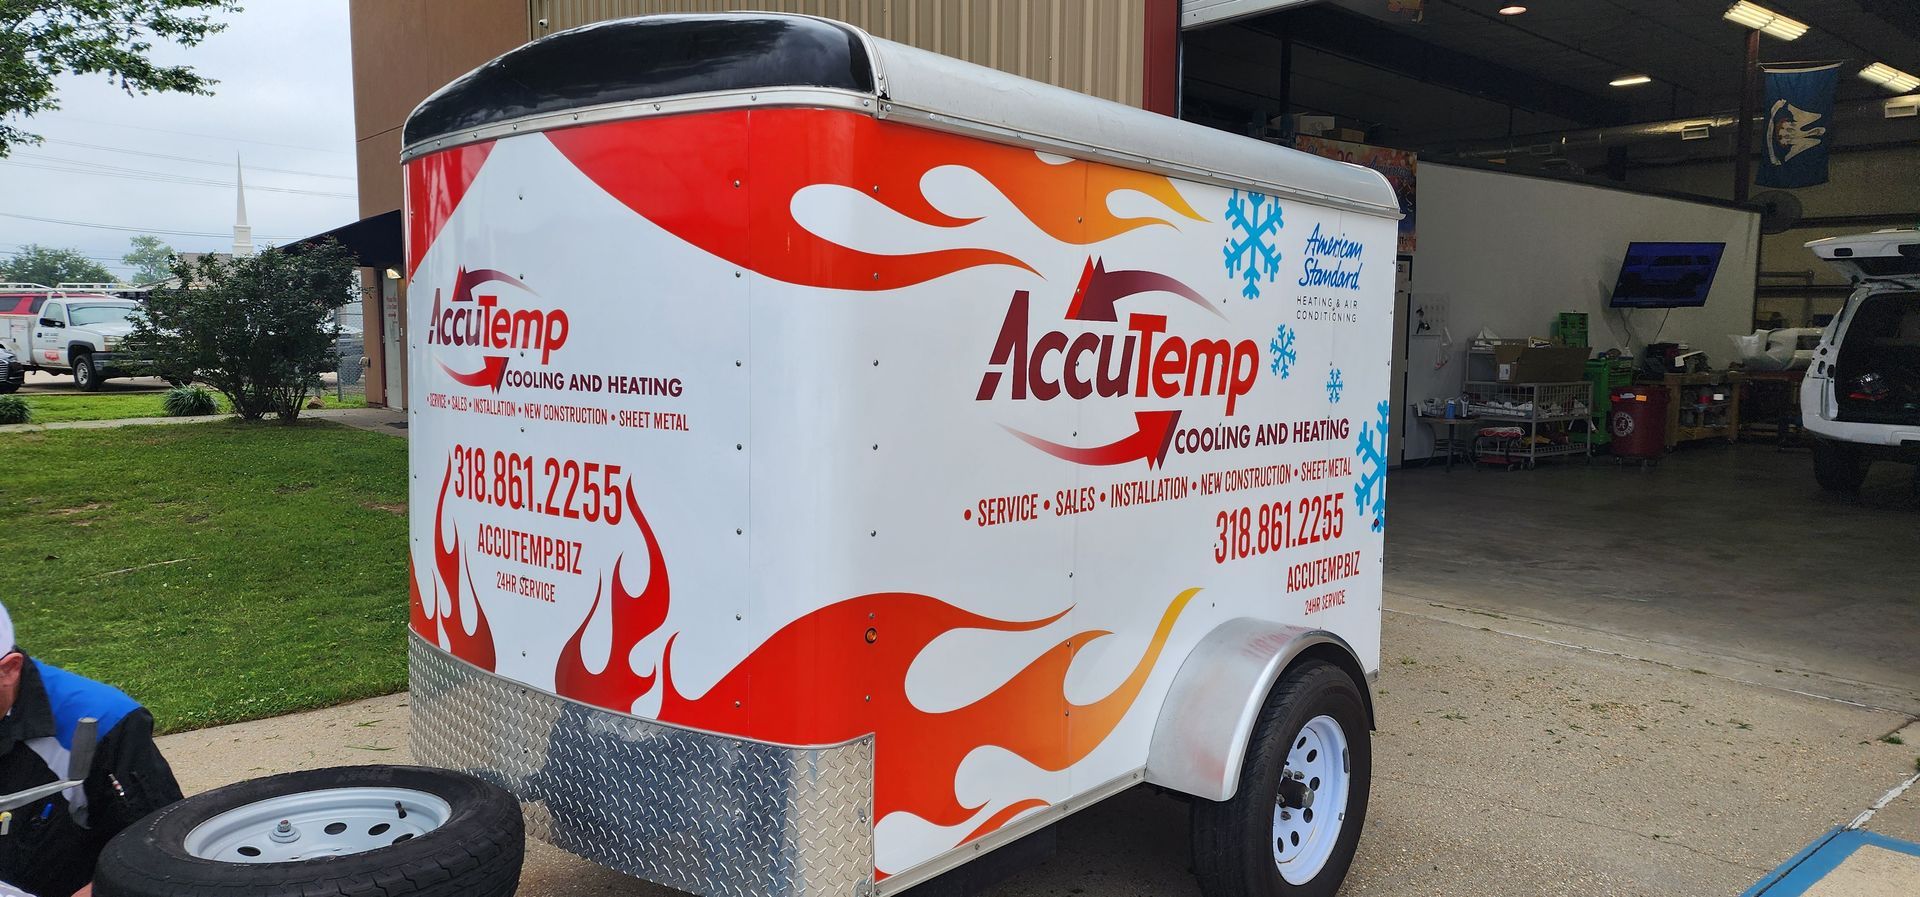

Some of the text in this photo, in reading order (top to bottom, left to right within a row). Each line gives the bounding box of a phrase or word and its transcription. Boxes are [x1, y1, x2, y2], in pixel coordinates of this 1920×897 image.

[1304, 222, 1363, 260] American
[1296, 296, 1358, 309] HEATING & AIR
[1296, 310, 1357, 323] CONDITIONING
[428, 288, 569, 365] AccuTemp
[975, 289, 1260, 416] AccuTemp
[505, 369, 683, 397] COOLING AND HEATING
[429, 392, 690, 431] SERVICE SALES INSTALLATION NEW CONSTRUCTION SHEET METAL
[1174, 418, 1350, 455] COOLING AND HEATING
[454, 443, 623, 526] 318.861.2255
[978, 493, 1039, 527] SERVICE
[1055, 486, 1096, 517] SALES
[1110, 476, 1189, 508] INSTALLATION
[1200, 472, 1223, 496] NEW
[1225, 464, 1292, 492] CONSTRUCTION
[1214, 492, 1345, 564] 318.861.2255
[477, 523, 583, 575] ACCUTEMP.BIZ
[496, 571, 556, 603] 24HR SERVICE
[1286, 550, 1361, 594] ACCUTEMP.BIZ
[1304, 589, 1346, 616] 24HR SERVICE
